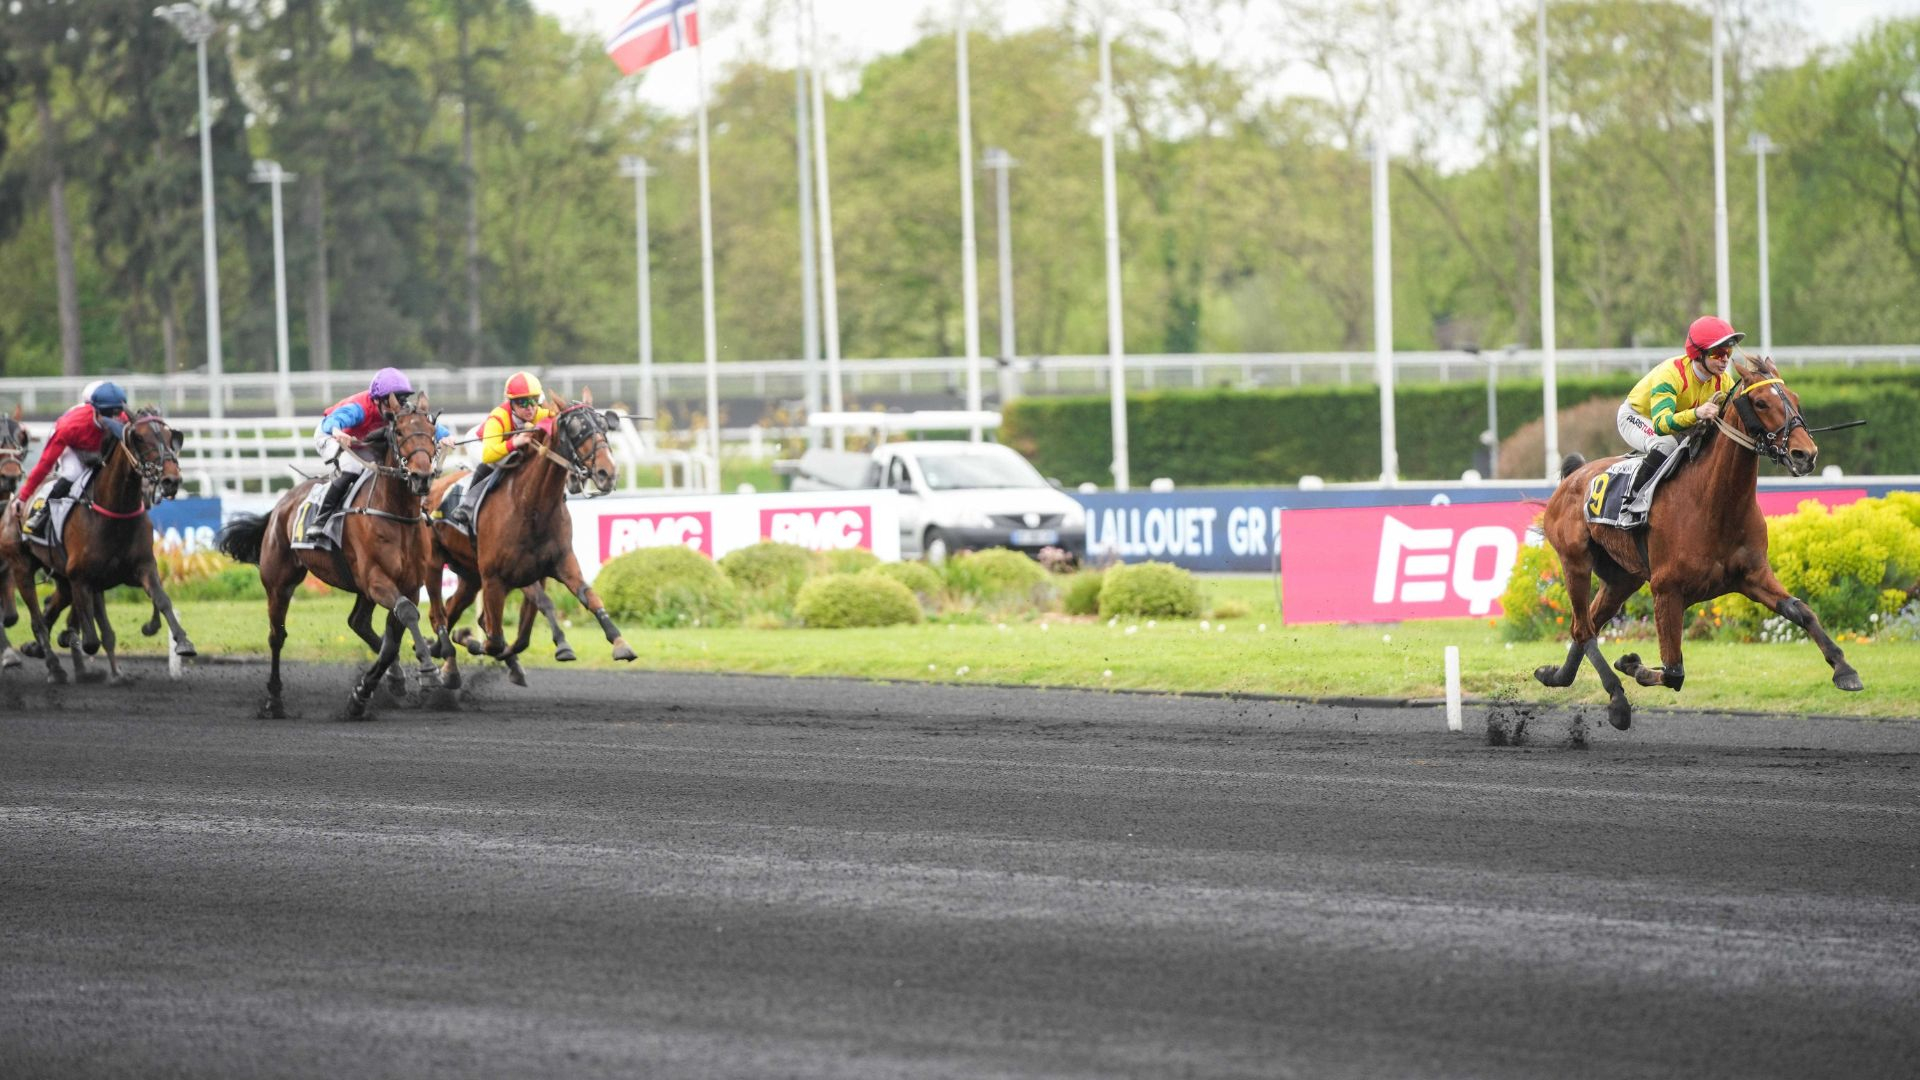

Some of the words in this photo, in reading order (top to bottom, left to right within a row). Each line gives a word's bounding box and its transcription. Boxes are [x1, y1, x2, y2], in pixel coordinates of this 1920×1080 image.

[1589, 472, 1610, 516] 9
[608, 515, 703, 558] RMC
[770, 510, 864, 551] RMC
[1085, 507, 1217, 556] LALLOUET
[1227, 506, 1268, 556] GR
